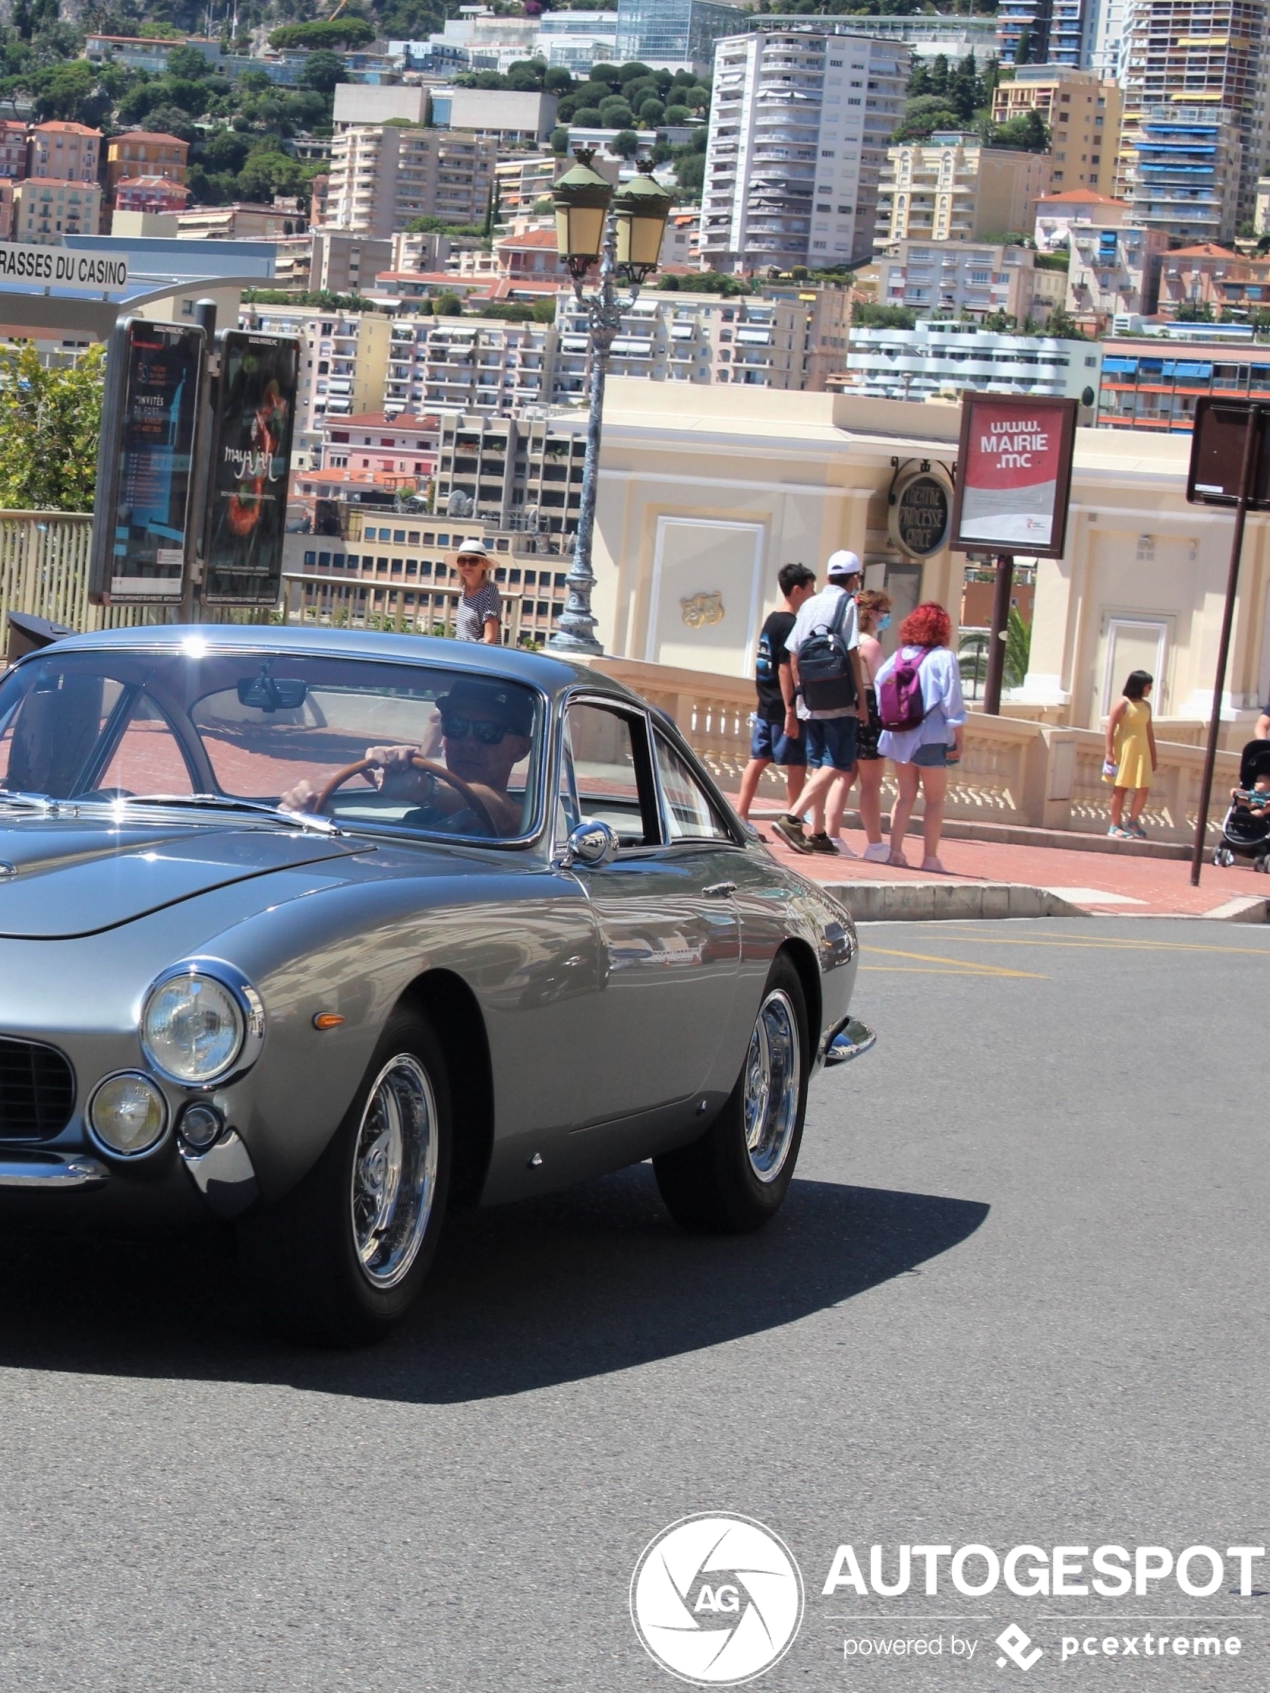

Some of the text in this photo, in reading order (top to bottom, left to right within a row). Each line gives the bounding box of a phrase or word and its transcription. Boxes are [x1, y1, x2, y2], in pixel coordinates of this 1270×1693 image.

[56, 256, 75, 281] DU
[78, 258, 127, 286] CASINO
[991, 421, 1041, 433] www.
[980, 434, 1049, 453] MAIRIE
